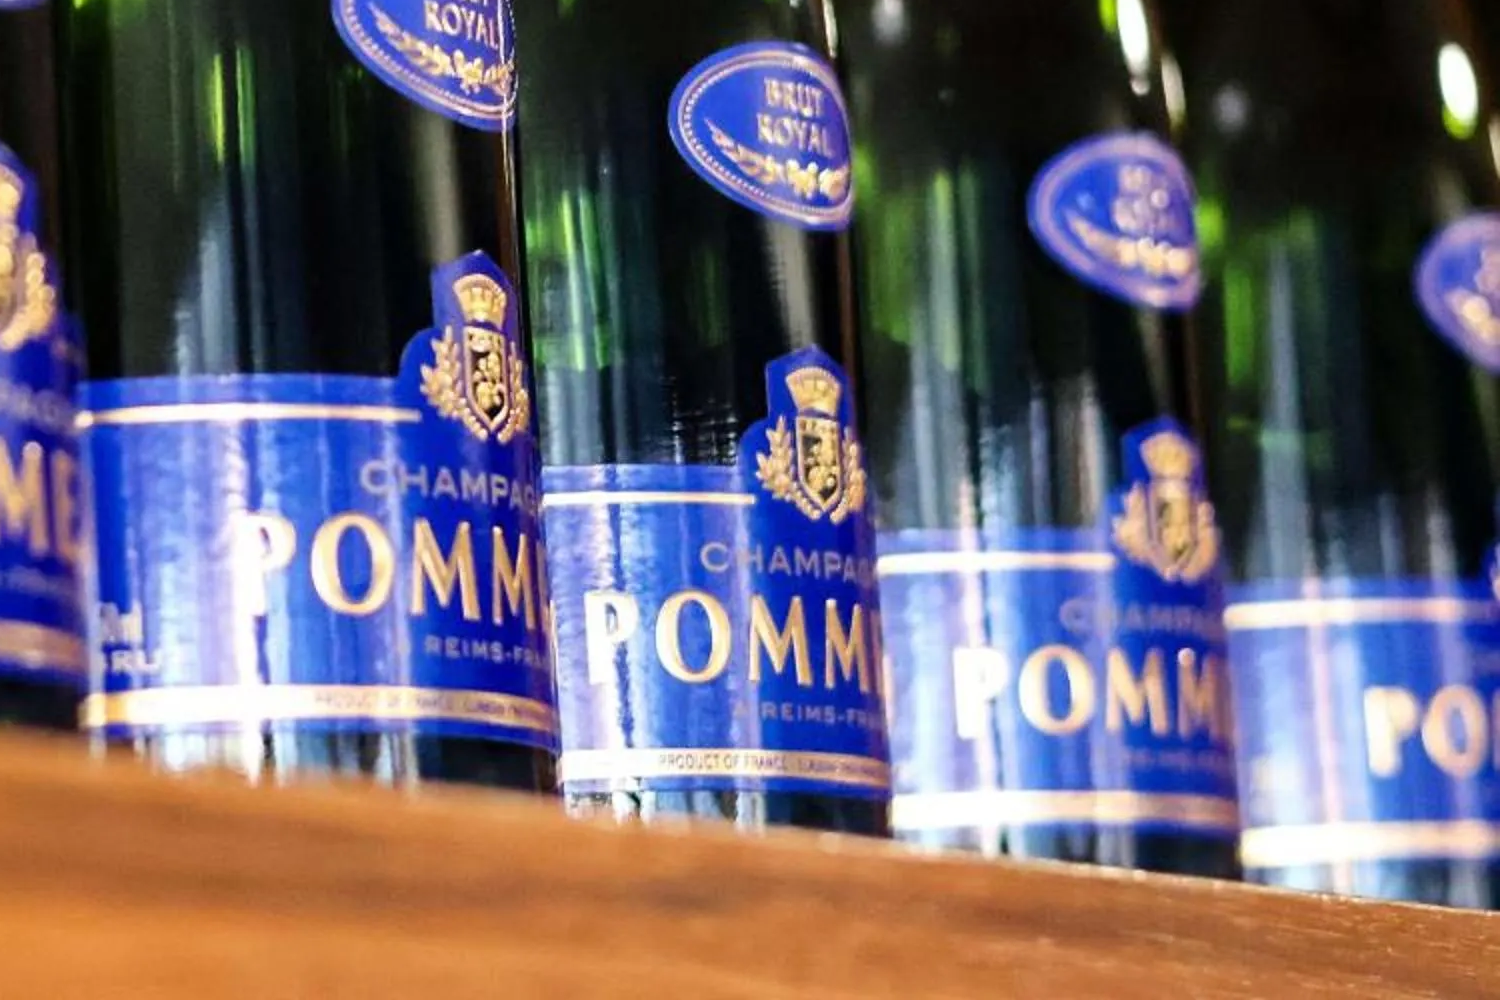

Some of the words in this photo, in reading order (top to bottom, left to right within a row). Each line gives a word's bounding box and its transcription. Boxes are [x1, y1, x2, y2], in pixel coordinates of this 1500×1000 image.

[757, 112, 832, 158] ROYAL
[764, 77, 823, 117] BRUT
[234, 510, 550, 632] POMM
[584, 588, 885, 695] POMM
[953, 643, 1232, 741] POMM
[1363, 684, 1500, 779] PO
[659, 753, 720, 771] PRODUCT
[722, 754, 739, 770] OF
